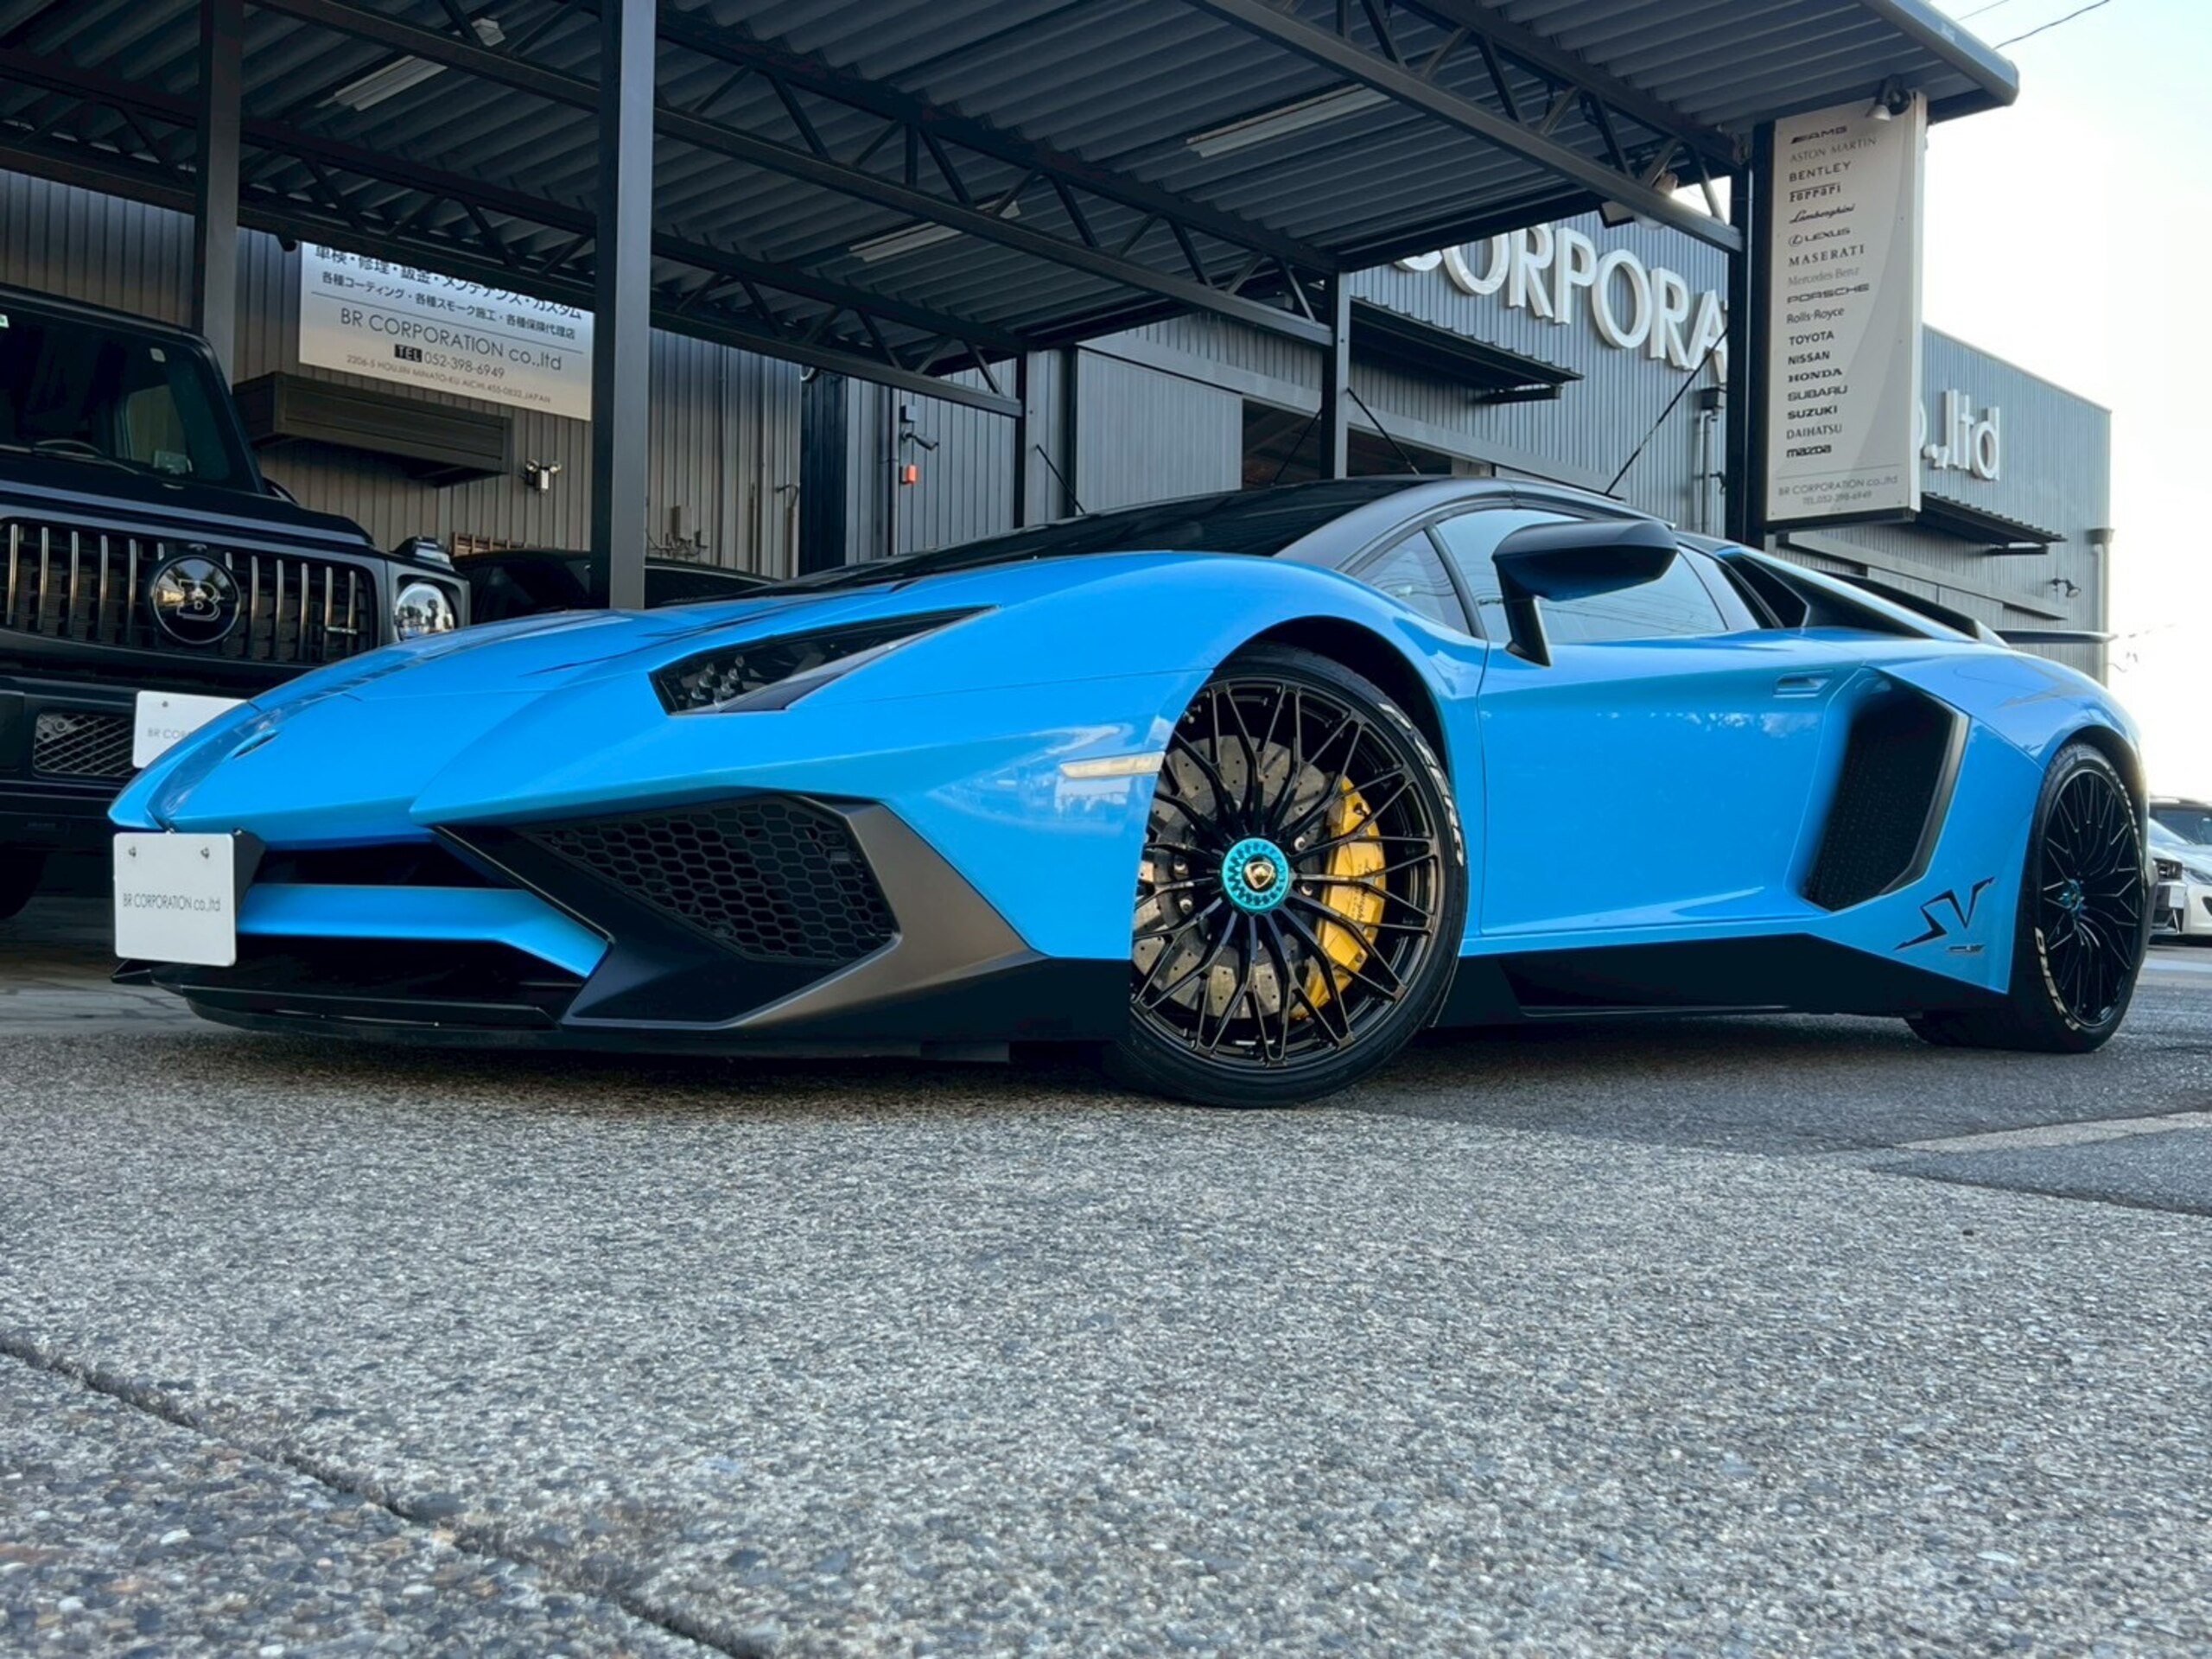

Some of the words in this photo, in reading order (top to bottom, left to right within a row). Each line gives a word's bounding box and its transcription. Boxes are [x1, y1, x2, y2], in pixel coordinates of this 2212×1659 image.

[1790, 149, 1826, 162] ASTON
[1831, 137, 1877, 153] MARTIN
[1789, 161, 1852, 182] BENTLEY
[1789, 182, 1841, 203] Ferrari
[1789, 204, 1856, 224] Lamborghini
[1804, 227, 1851, 243] LEXUS
[1788, 244, 1865, 268] MASERATI
[1786, 283, 1870, 304] PORSCHE
[1393, 224, 1727, 384] ORPORA
[340, 308, 363, 328] BR
[369, 315, 504, 358] CORPORATION
[1789, 330, 1834, 346] TOYOTA
[397, 345, 422, 361] TEL
[423, 350, 505, 378] 052-398-6949
[1788, 350, 1830, 365] NISSAN
[1788, 368, 1843, 383] HONDA
[1788, 385, 1848, 402] SUBARU
[1788, 405, 1838, 420] SUZUKI
[1786, 424, 1842, 440] DAIHATSU
[1792, 479, 1865, 494] CORPORATION
[123, 893, 131, 907] BR
[134, 893, 192, 910] CORPORATION
